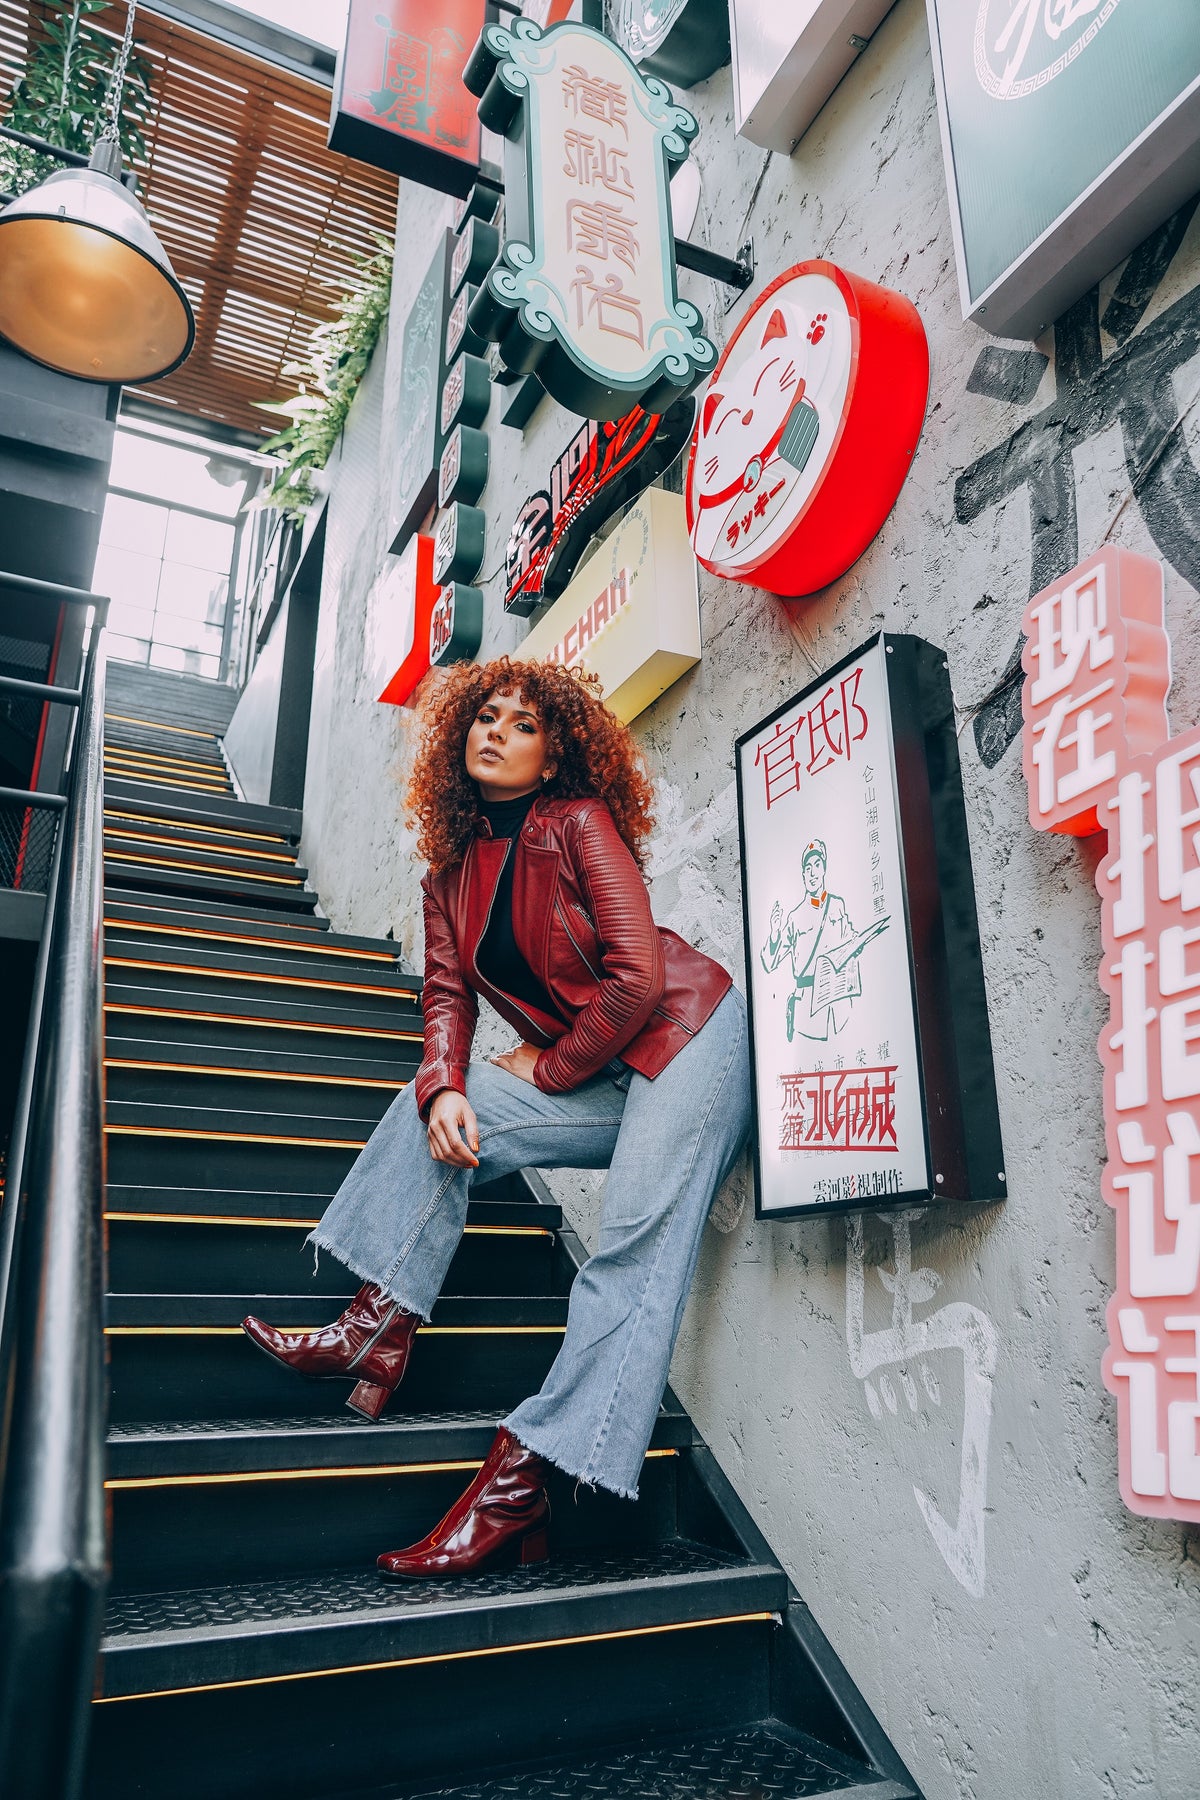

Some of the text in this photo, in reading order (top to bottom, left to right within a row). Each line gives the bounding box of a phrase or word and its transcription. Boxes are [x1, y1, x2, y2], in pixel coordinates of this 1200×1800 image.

[726, 477, 786, 548] ラッキー
[754, 668, 868, 810] 官邸
[1030, 562, 1117, 815] 现在
